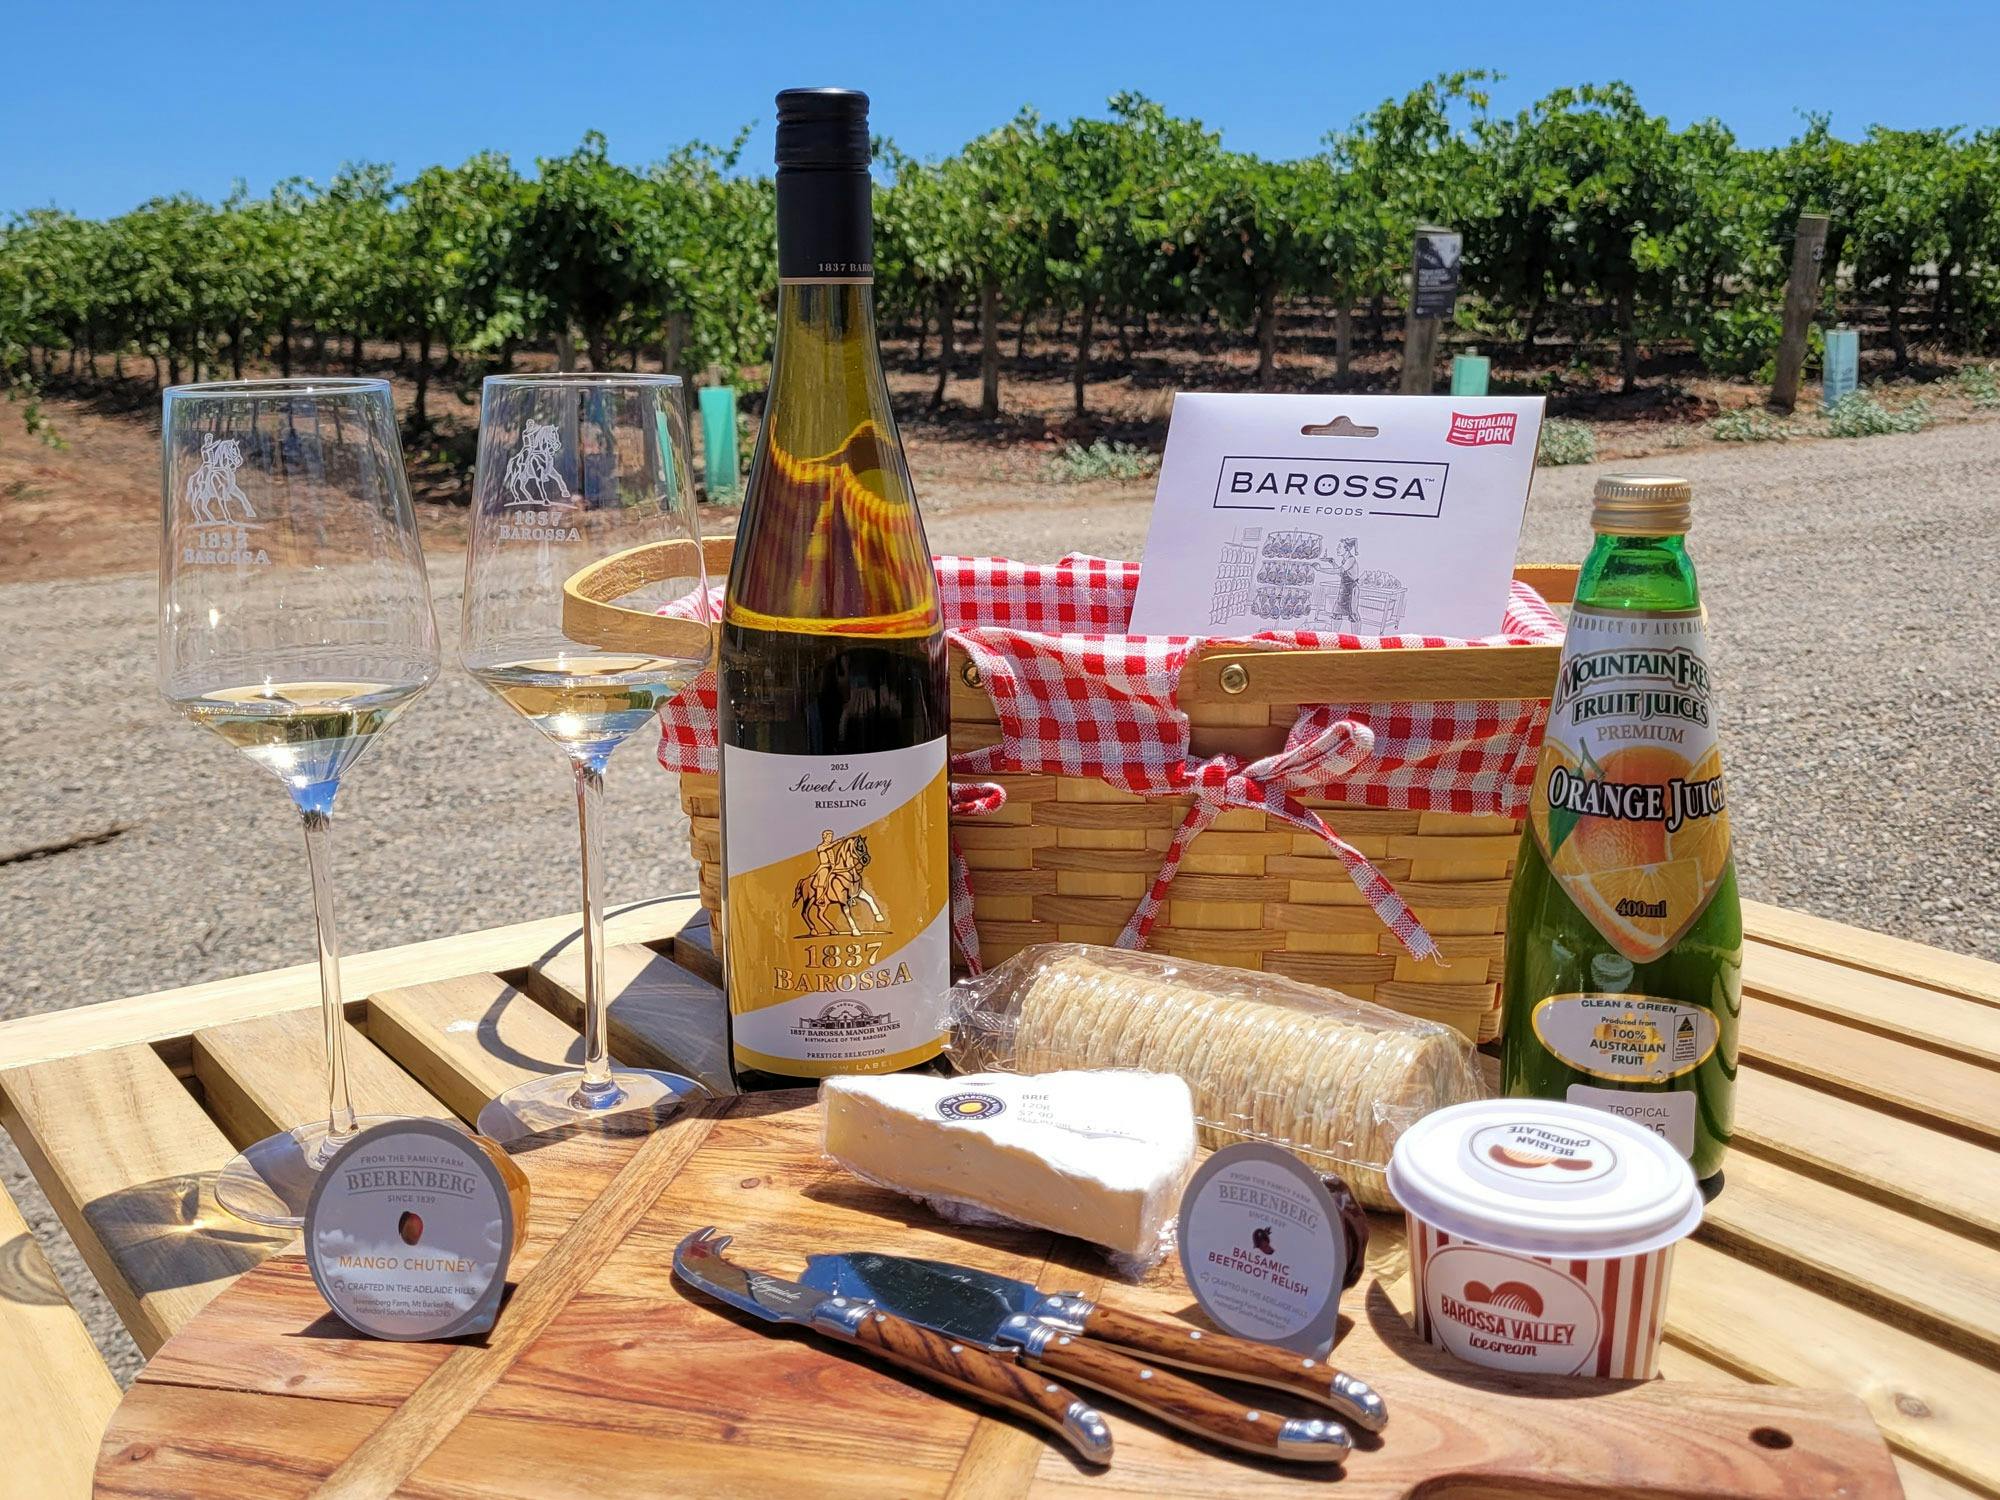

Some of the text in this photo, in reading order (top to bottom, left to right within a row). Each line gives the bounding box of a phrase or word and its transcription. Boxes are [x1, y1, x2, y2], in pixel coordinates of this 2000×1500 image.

[818, 263, 847, 272] 1837
[1454, 416, 1514, 429] AUSTRALIAN
[1476, 428, 1512, 443] PORK
[514, 510, 563, 526] 1837
[1280, 505, 1363, 516] FINE FOODS
[499, 525, 582, 542] BAROSSA
[1573, 615, 1624, 634] PRODUCT
[1631, 622, 1647, 635] OF
[1574, 692, 1709, 726] FRUIT JUICES
[1596, 725, 1685, 744] PREMIUM
[830, 763, 849, 771] 2023
[789, 771, 893, 796] Sweet Mary
[815, 799, 867, 809] RIESLING
[1549, 765, 1726, 833] ORANGE JUICE
[1615, 898, 1667, 917] 400ml
[805, 941, 883, 969] 1837
[774, 961, 913, 993] BAROSSA
[1581, 1000, 1677, 1014] CLEAN & GREEN
[1601, 1016, 1657, 1027] Produced from
[845, 1028, 875, 1037] MANOR
[876, 1022, 901, 1032] WINES
[1612, 1029, 1647, 1040] 100%
[844, 1048, 886, 1058] SELECTION
[1589, 1040, 1666, 1053] AUSTRALIAN
[856, 1060, 893, 1071] LABEL
[1610, 1054, 1645, 1066] FRUIT
[1608, 1105, 1670, 1117] TROPICAL
[1507, 1125, 1591, 1148] CHOCOLATE
[1515, 1135, 1575, 1157] BELGIAN
[360, 1155, 464, 1167] FROM THE FAMILY FARM
[346, 1170, 476, 1194] BEERENBERG
[388, 1194, 413, 1203] SINCE
[1218, 1184, 1318, 1229] BEERENBERG
[340, 1255, 477, 1273] MANGO CHUTNEY
[1232, 1247, 1290, 1276] BALSAMIC
[1208, 1251, 1309, 1297] BEETROOT RELISH
[347, 1282, 476, 1295] CRAFTED IN THE ADELAIDE HILLS
[1441, 1294, 1576, 1344] BAROSSA VALLEY
